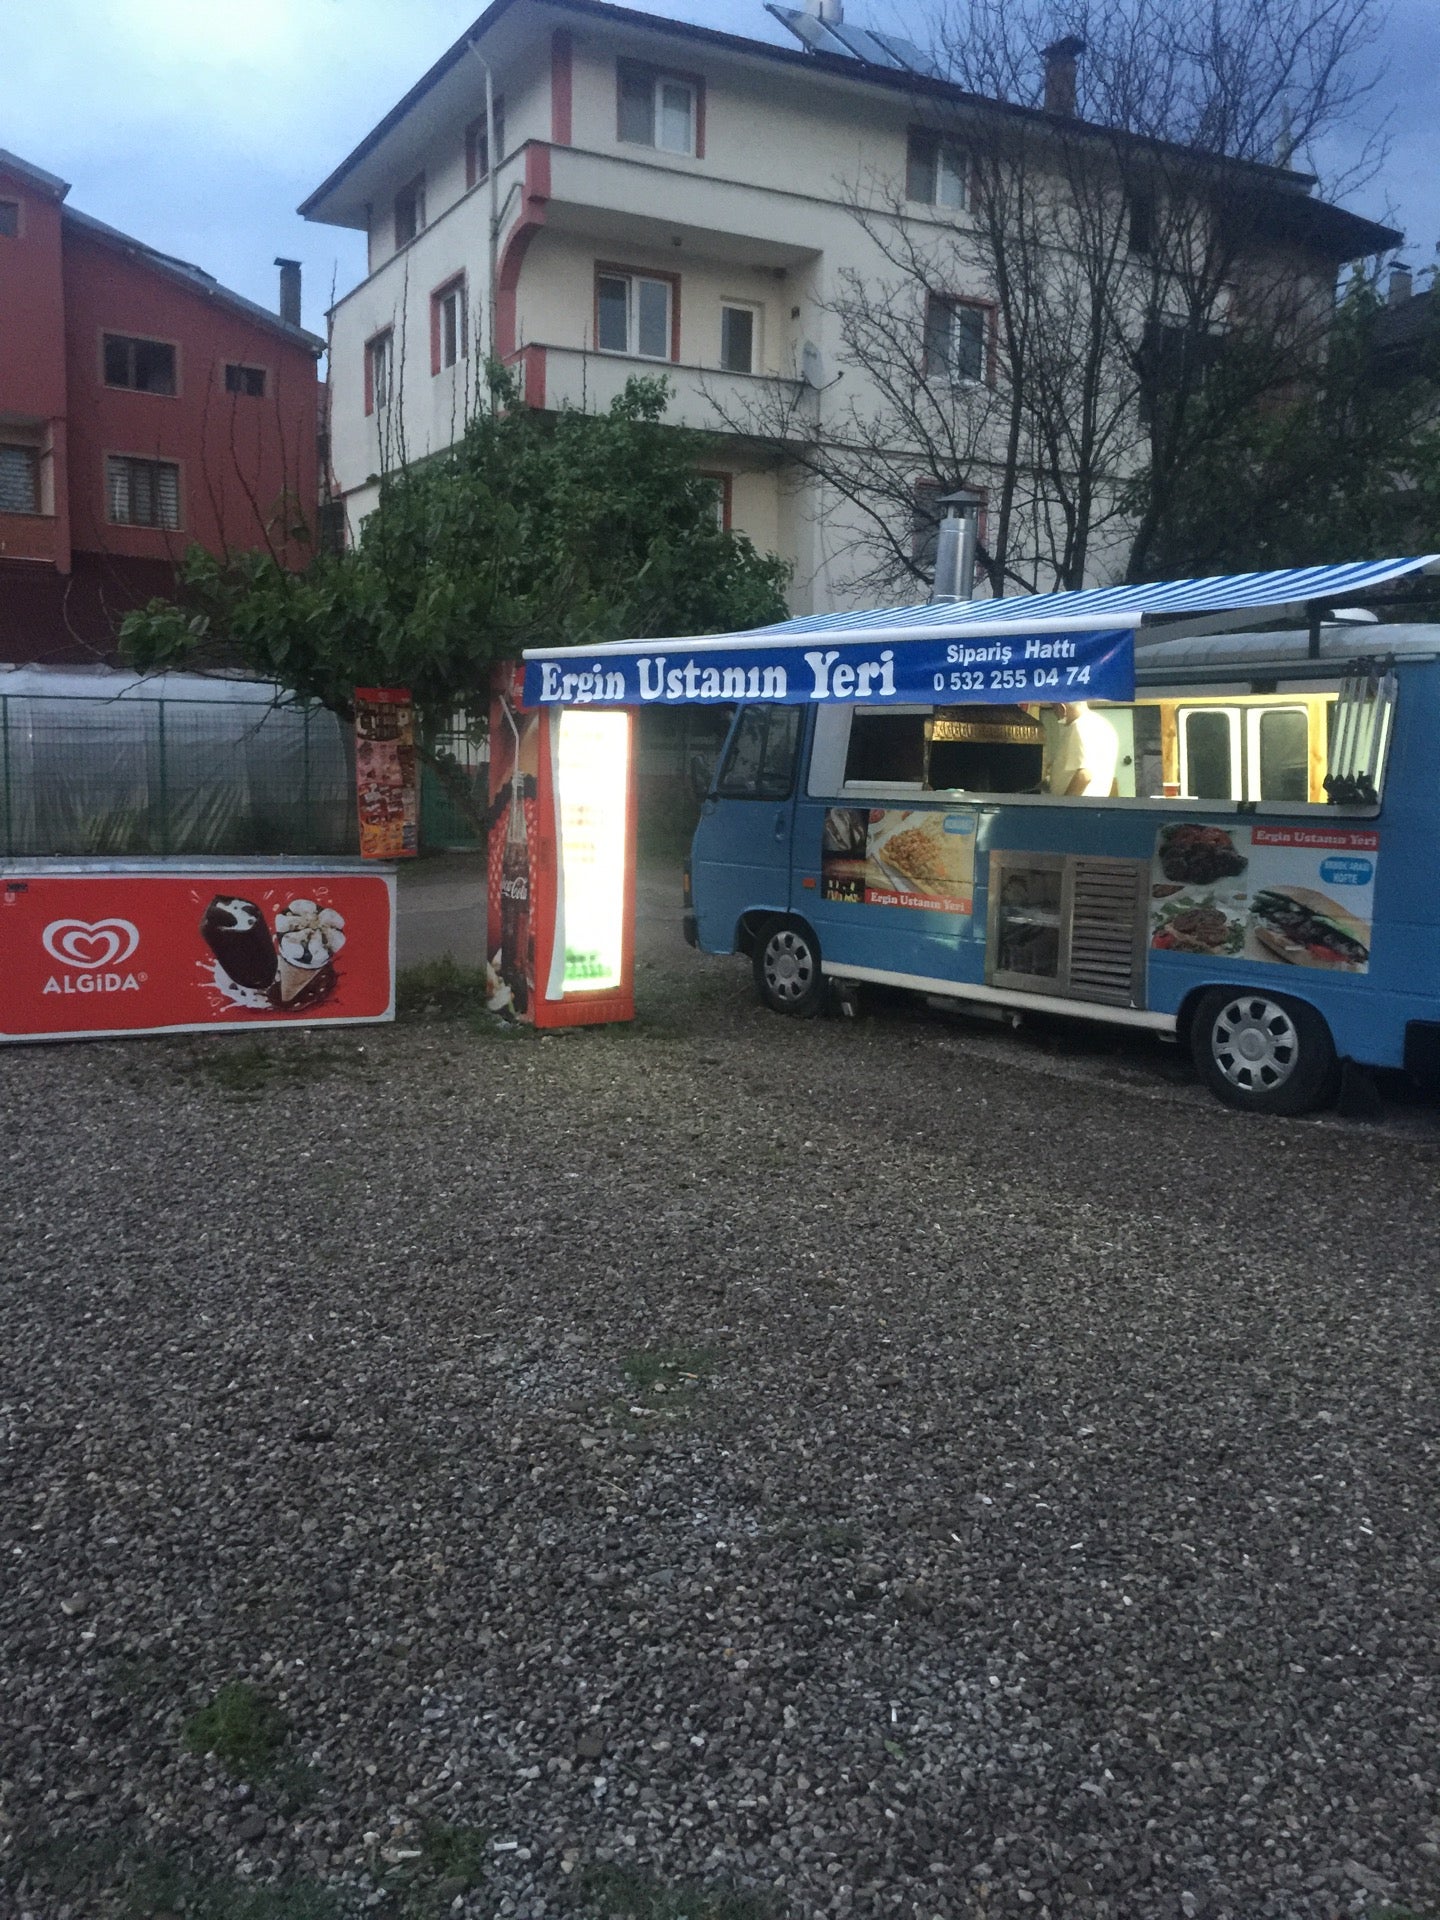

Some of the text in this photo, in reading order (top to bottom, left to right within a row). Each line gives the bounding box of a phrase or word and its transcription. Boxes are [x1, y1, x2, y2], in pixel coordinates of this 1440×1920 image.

[946, 639, 1076, 666] Sipariş Hattı
[540, 650, 897, 703] Ergin Ustanın Yeri
[933, 665, 1091, 692] 0 532 255 04 74
[1256, 830, 1291, 842] Ergin
[1350, 834, 1377, 845] Yeri
[871, 892, 898, 905] Ergin
[943, 900, 965, 911] Yeri
